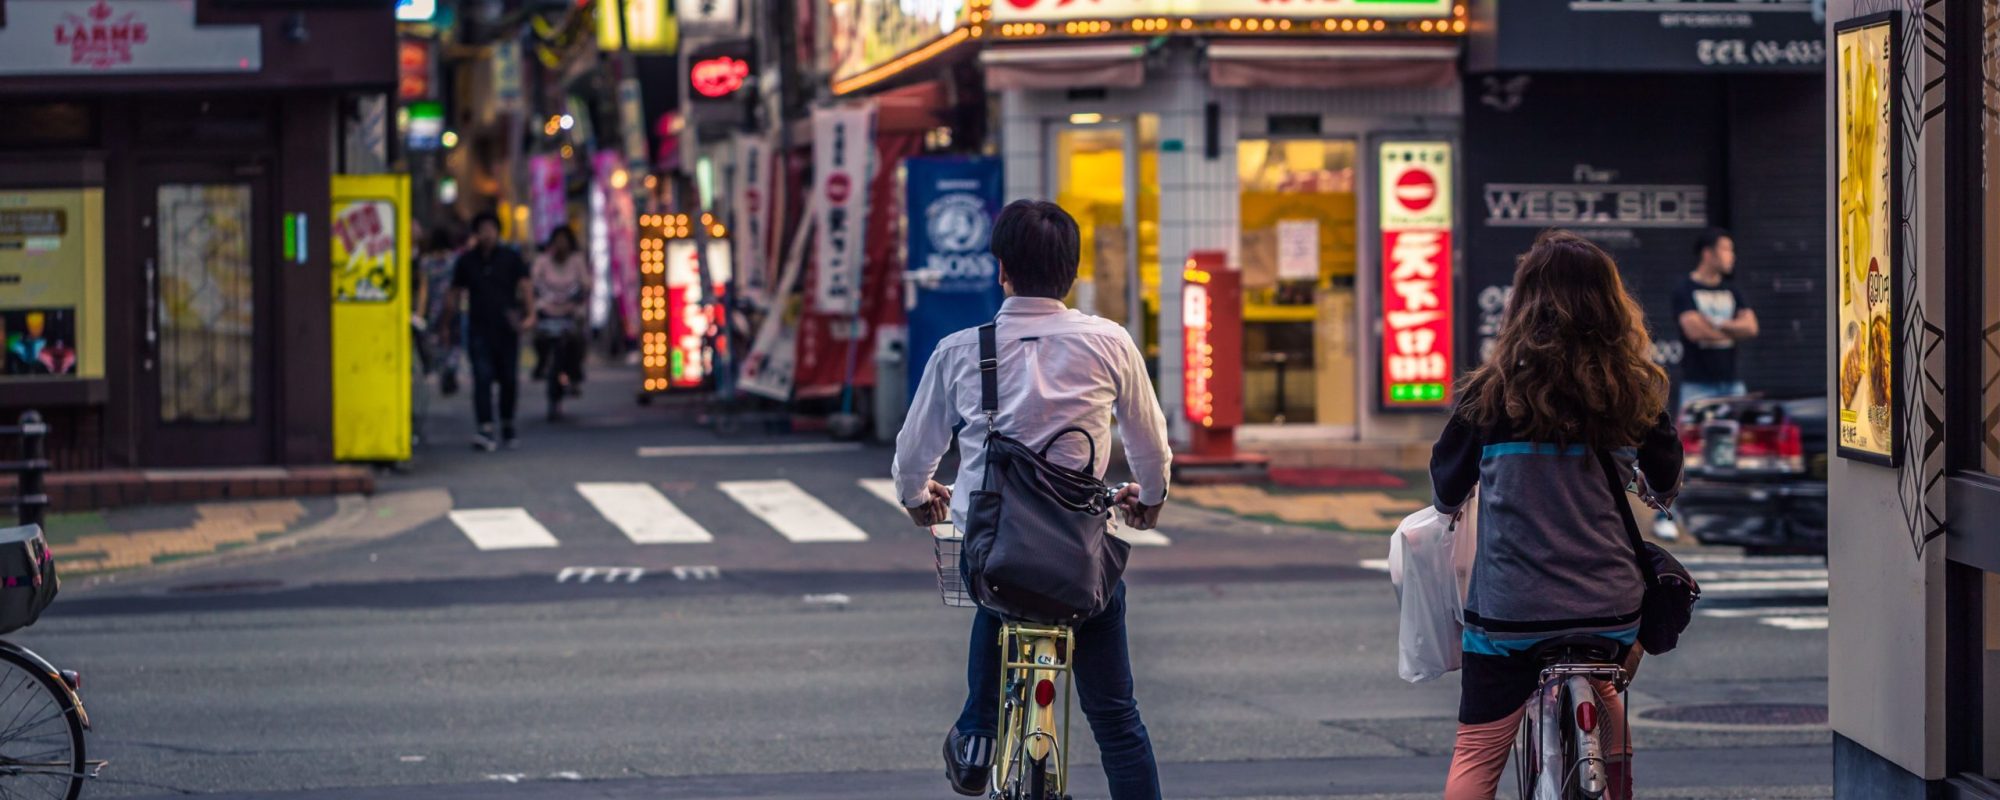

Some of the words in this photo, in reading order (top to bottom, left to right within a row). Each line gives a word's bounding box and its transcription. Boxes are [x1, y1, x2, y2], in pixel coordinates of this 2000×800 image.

[53, 24, 148, 45] LARME
[1616, 190, 1707, 222] SIDE
[926, 253, 996, 277] BOSS
[1387, 232, 1447, 381] 天下一品
